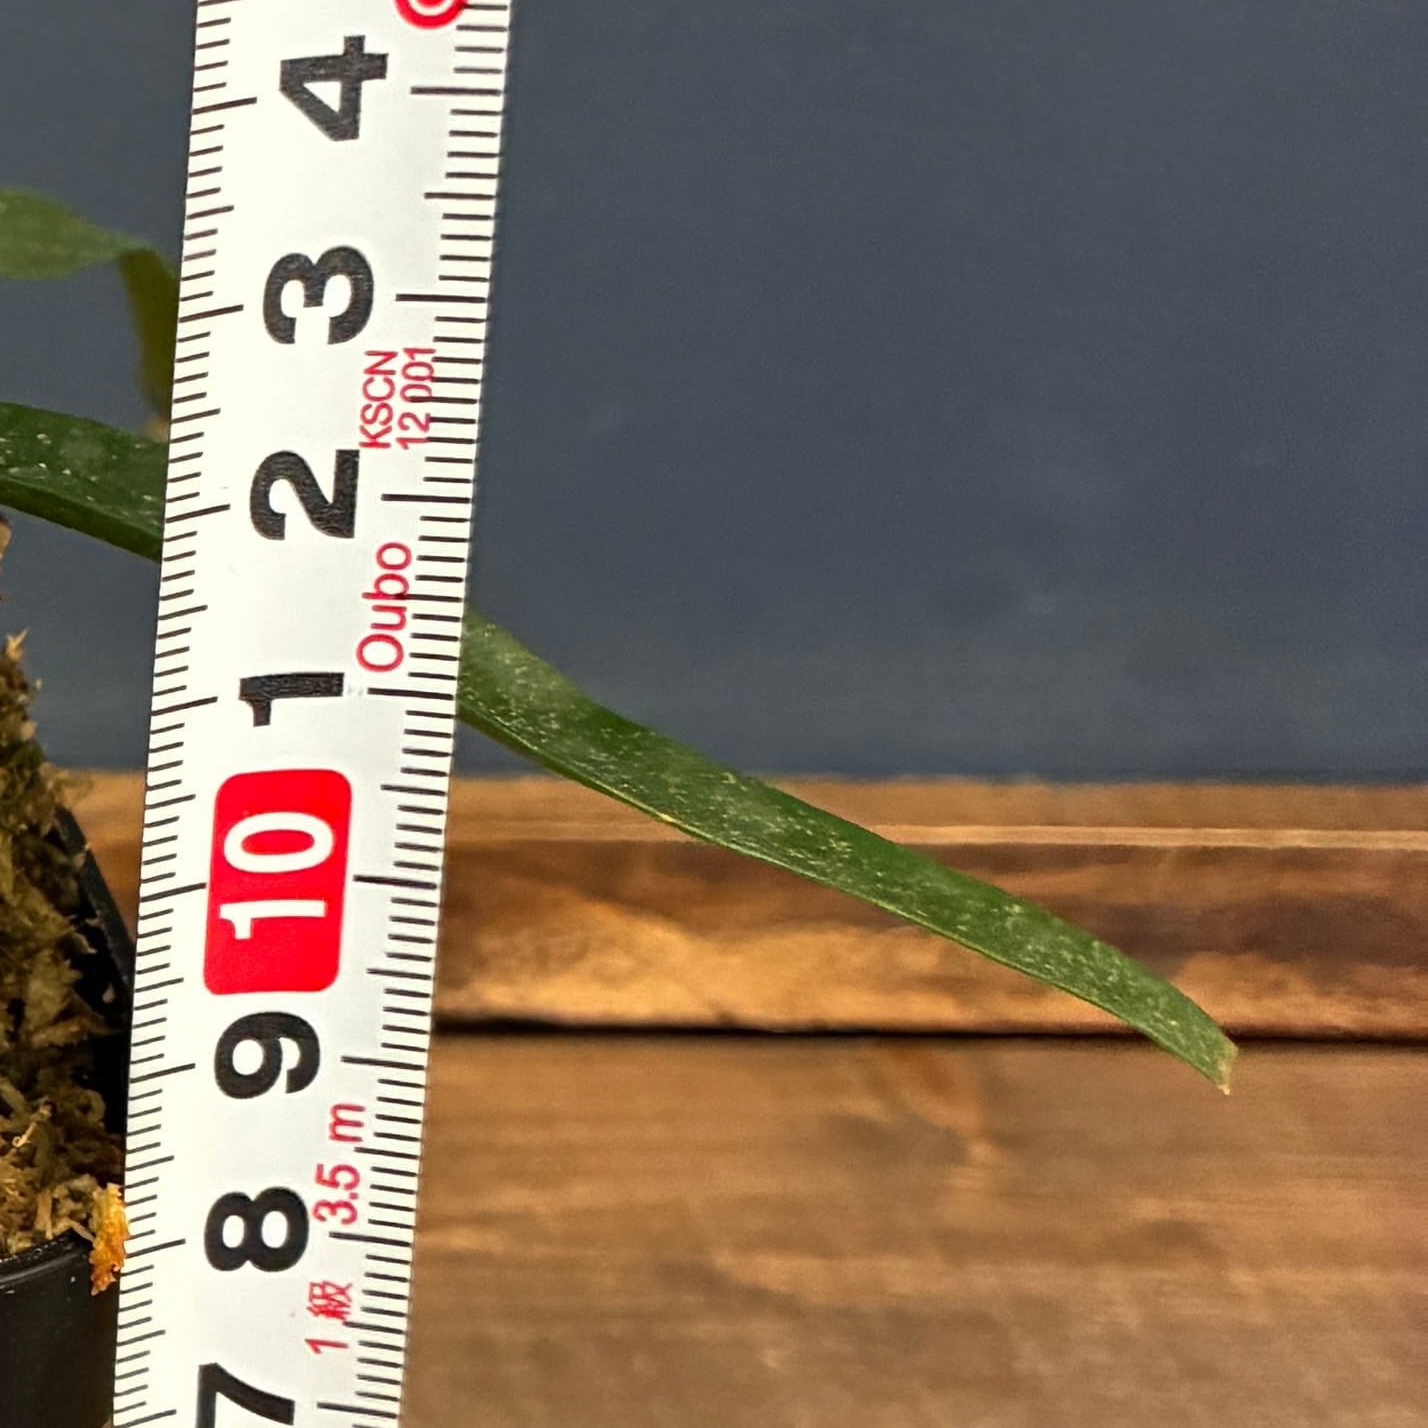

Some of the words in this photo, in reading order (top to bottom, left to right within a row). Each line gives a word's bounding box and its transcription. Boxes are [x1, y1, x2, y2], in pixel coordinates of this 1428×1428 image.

[280, 35, 389, 141] 4
[263, 245, 374, 345] 3
[358, 350, 398, 449] KSCN
[250, 449, 360, 541] 2
[356, 541, 412, 673] Oubo
[239, 672, 344, 726] 1
[219, 810, 334, 940] 10
[214, 1011, 320, 1100] 9
[328, 1103, 366, 1142] m
[204, 1186, 309, 1272] 8
[312, 1163, 361, 1226] 3.5
